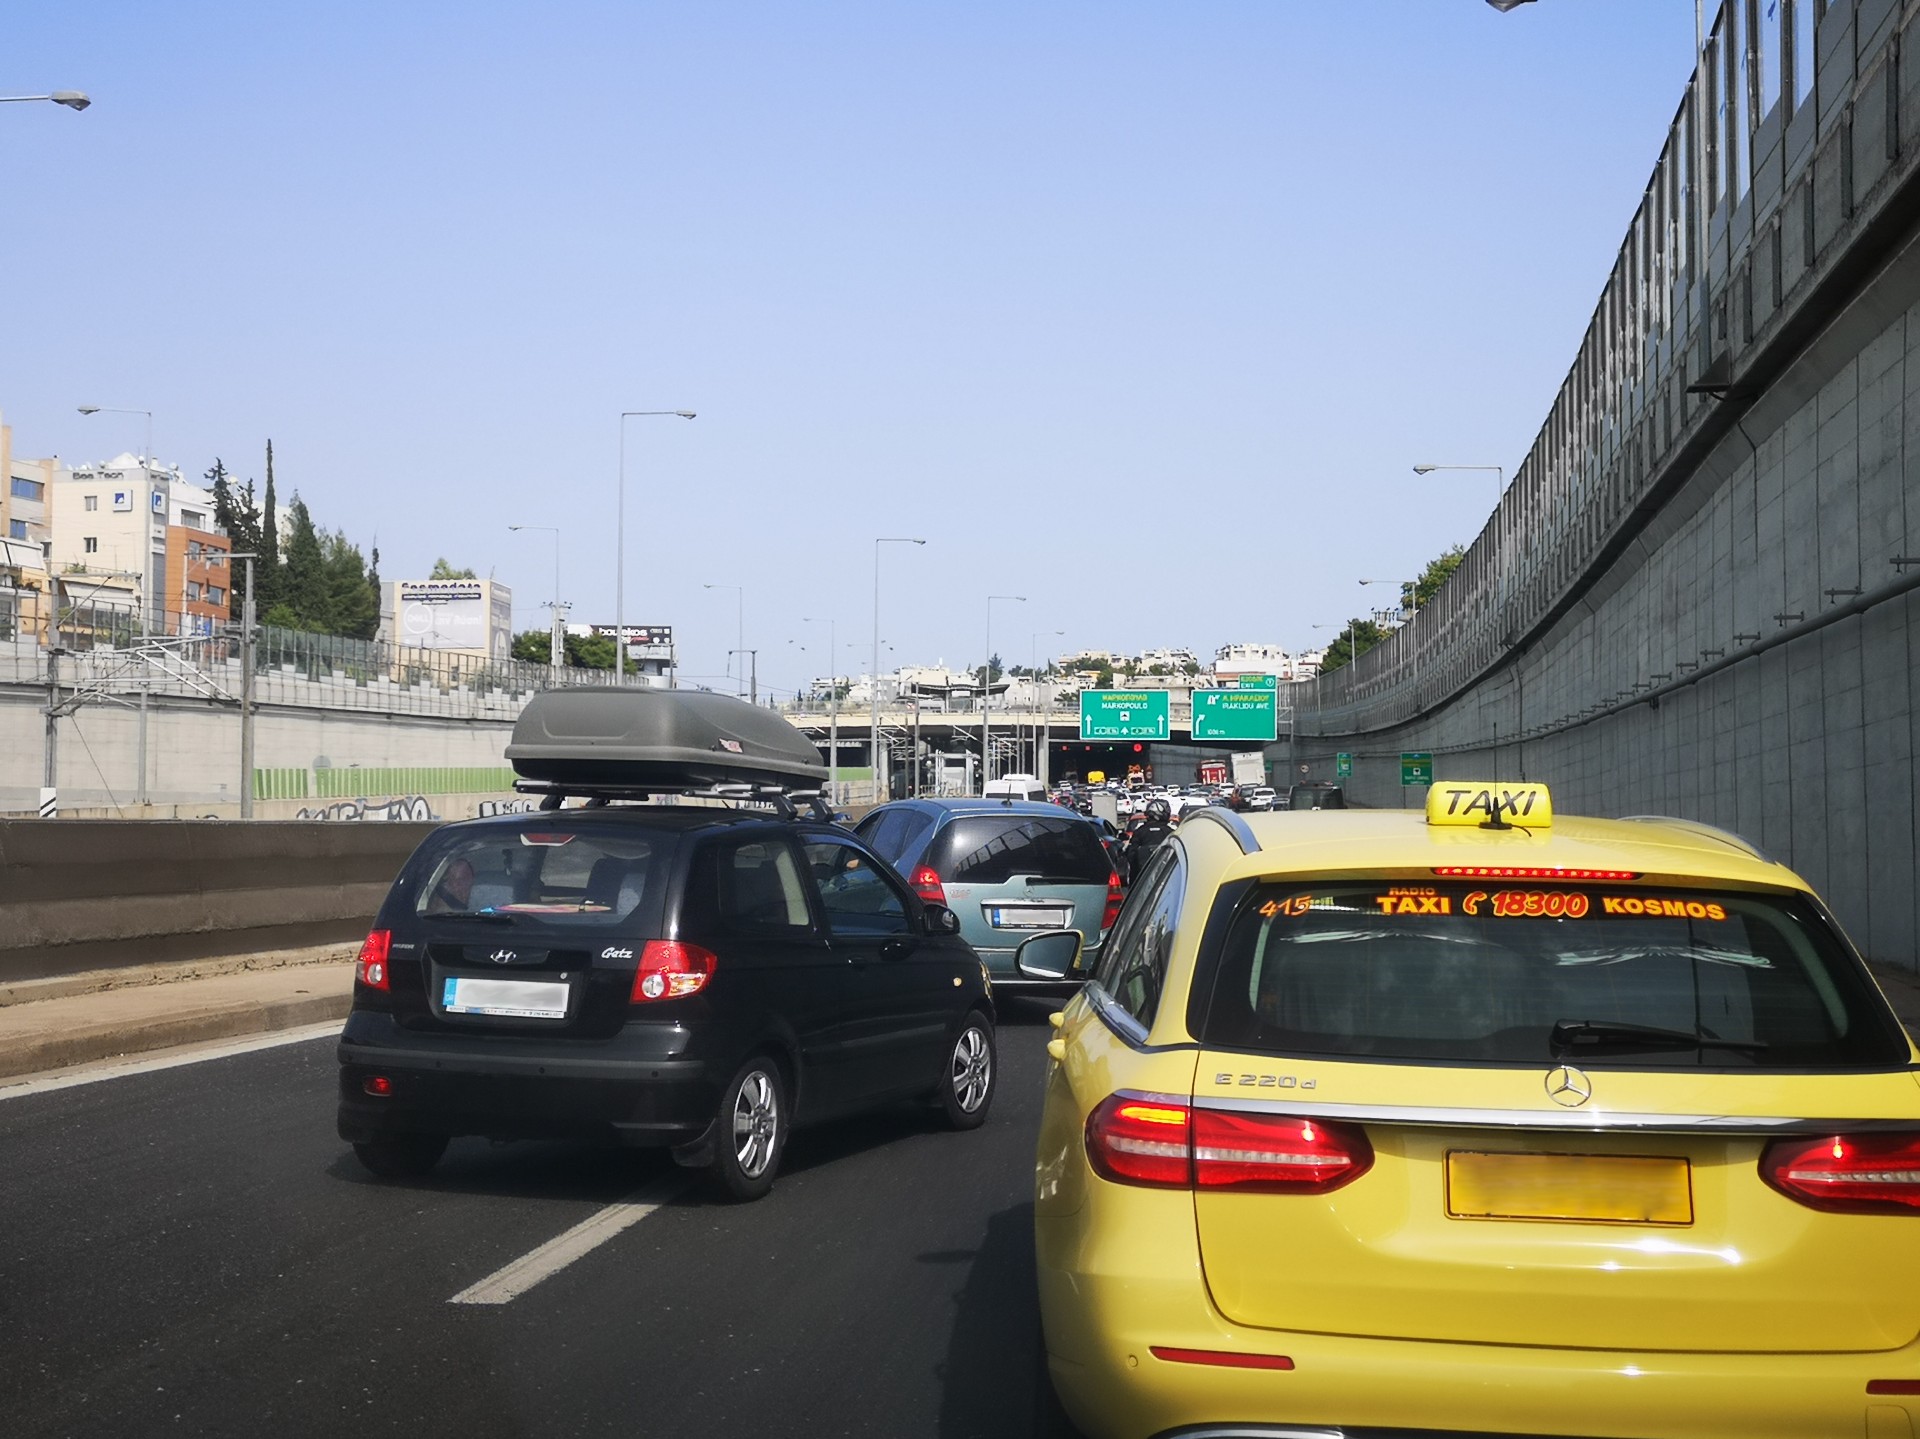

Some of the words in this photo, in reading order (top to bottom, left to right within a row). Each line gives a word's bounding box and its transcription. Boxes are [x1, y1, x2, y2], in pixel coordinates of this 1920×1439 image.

[1446, 790, 1536, 815] TAXI
[1388, 887, 1436, 896] RADIO
[1259, 895, 1312, 917] 415
[1376, 896, 1452, 915] TAXI
[1491, 889, 1589, 918] 18300
[1602, 897, 1727, 921] KOSMOS
[601, 946, 633, 959] Getz
